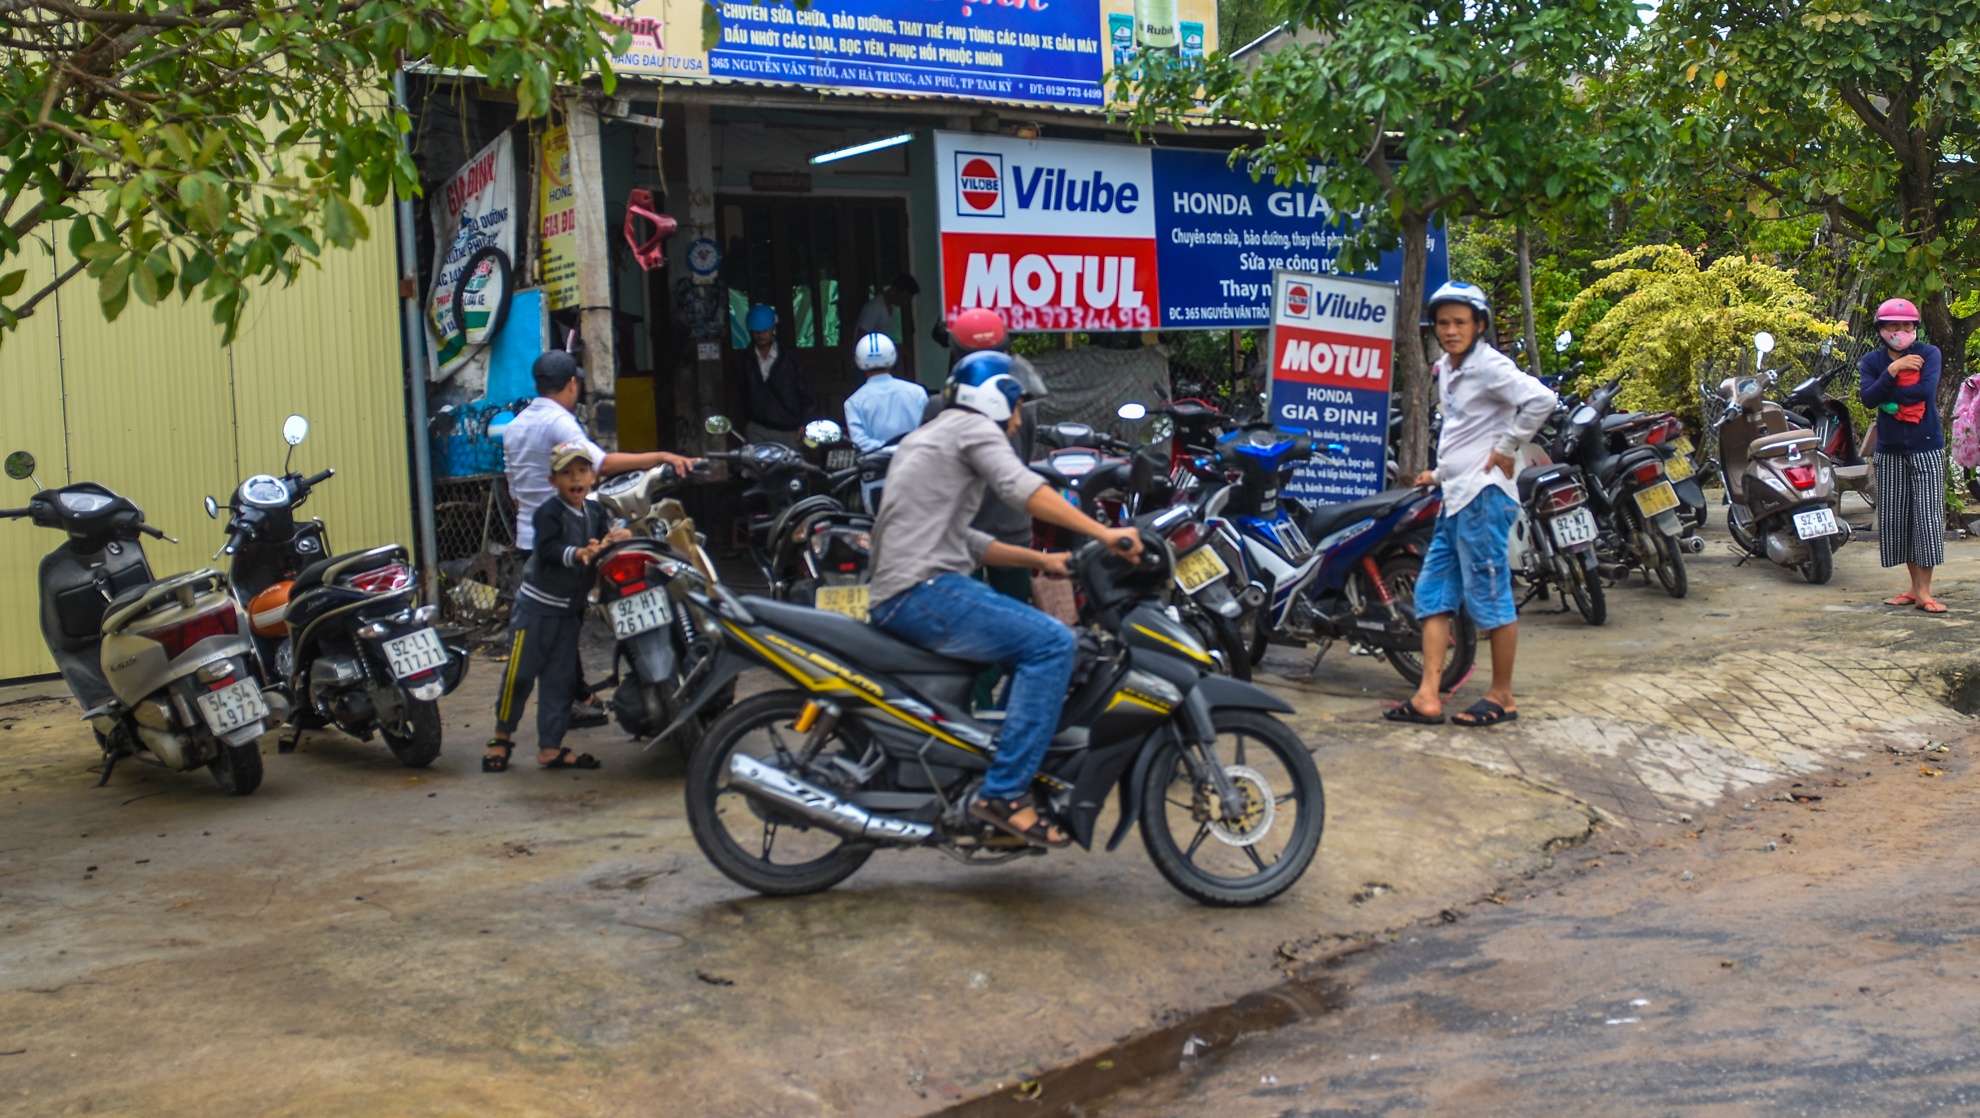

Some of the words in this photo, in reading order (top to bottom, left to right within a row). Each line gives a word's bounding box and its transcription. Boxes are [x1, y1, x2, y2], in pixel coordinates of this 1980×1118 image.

[770, 4, 794, 25] SỬA
[796, 8, 831, 29] CHỮA,
[832, 10, 855, 30] BẢO
[857, 14, 896, 36] DƯỠNG,
[898, 20, 923, 37] THAY
[925, 20, 944, 39] THẾ
[946, 25, 966, 44] PHỤ
[968, 25, 995, 44] TÙNG
[996, 28, 1017, 46] CÁC
[1018, 32, 1040, 51] LOẠI
[1041, 35, 1054, 50] XE
[1077, 37, 1098, 54] MÁY
[750, 28, 780, 47] NHỚT
[782, 30, 806, 49] CÁC
[808, 34, 838, 54] LOẠI,
[839, 37, 861, 57] BỌC
[863, 38, 887, 58] YÊN,
[889, 42, 917, 62] PHỤC
[939, 46, 973, 66] PHUỘC
[974, 49, 1003, 67] NHÚN
[682, 58, 703, 70] USA
[711, 56, 730, 69] 365
[731, 55, 781, 74] NGUYỄN
[782, 60, 807, 76] VĂN
[840, 68, 857, 80] AN
[858, 66, 875, 81] HÀ
[875, 70, 917, 86] TRUNG,
[917, 74, 933, 86] AN
[934, 73, 960, 90] PHÚ,
[960, 77, 975, 89] TP
[975, 79, 998, 91] TAM
[1029, 83, 1045, 95] ĐT:
[1045, 85, 1066, 97] 0129
[1067, 86, 1081, 98] 773
[1082, 88, 1103, 99] 4499
[1012, 165, 1139, 214] Vilube
[1173, 191, 1253, 216] HONDA
[1267, 191, 1332, 218] GIA
[1172, 227, 1205, 247] Chuyên
[1206, 231, 1222, 245] sơn
[1243, 229, 1260, 245] bảo
[1292, 230, 1310, 250] thay
[1311, 230, 1327, 246] thế
[1240, 252, 1265, 270] Sửa
[1267, 257, 1284, 270] xe
[1286, 254, 1319, 275] công
[961, 252, 1144, 309] MOTUL
[1219, 279, 1258, 301] Thay
[1185, 307, 1199, 319] 365
[1200, 302, 1234, 319] NGUYỄN
[1235, 305, 1252, 319] VĂN
[1316, 291, 1387, 323] Vilube
[1280, 339, 1384, 380] MOTUL
[1307, 387, 1354, 405] HONDA
[1281, 404, 1319, 422] GIA
[1324, 407, 1378, 427] ĐỊNH
[1561, 525, 1590, 544] 1427
[618, 591, 656, 617] 92-H1
[617, 606, 666, 635] 261.11
[394, 647, 441, 675] 217.71
[208, 684, 251, 712] 54-S4
[217, 701, 259, 728] 4972
